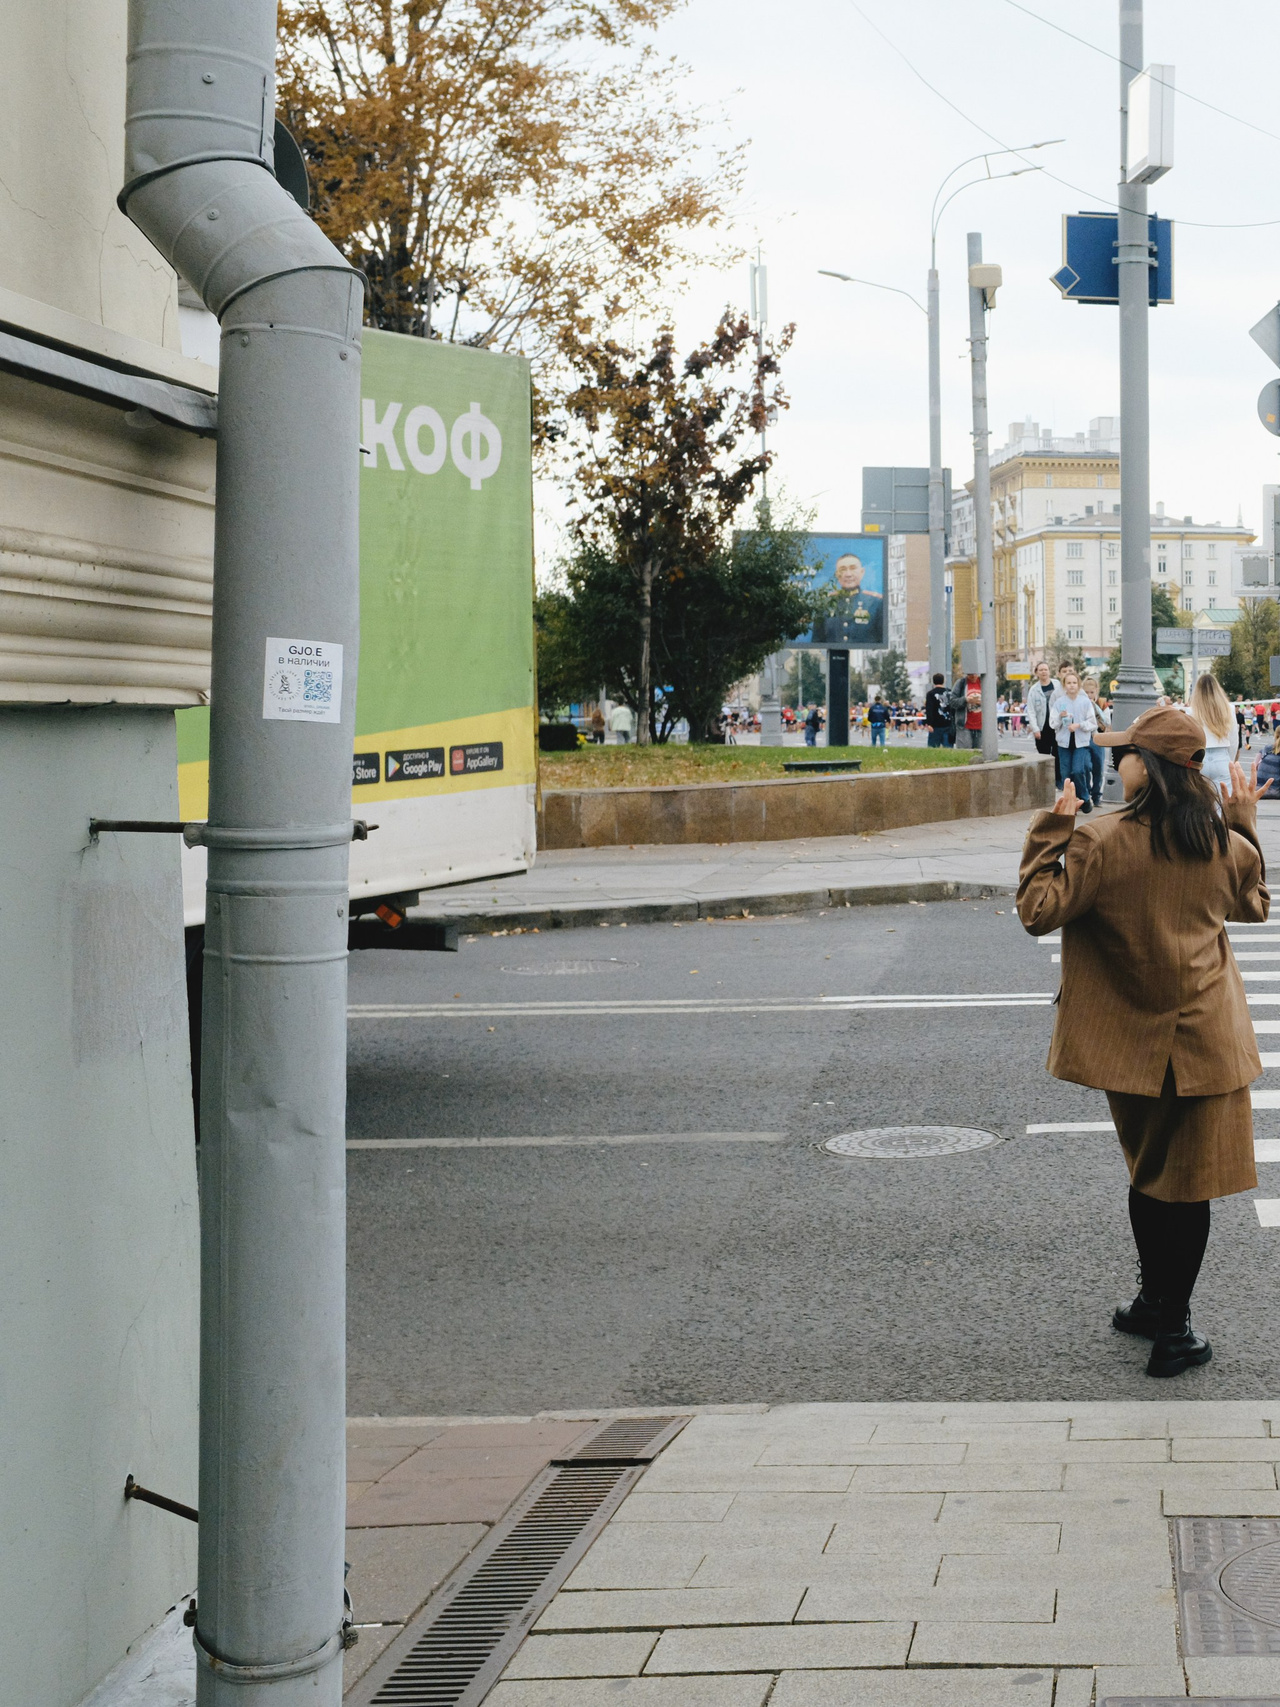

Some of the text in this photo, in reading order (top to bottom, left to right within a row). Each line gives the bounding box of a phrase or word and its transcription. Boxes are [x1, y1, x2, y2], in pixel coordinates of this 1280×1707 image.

[288, 645, 323, 657] GJO.E
[287, 657, 330, 667] наличии
[402, 752, 426, 761] ДОСТУПНО
[466, 755, 498, 770] AppGallery
[355, 766, 377, 780] Store
[402, 760, 443, 777] Google Play
